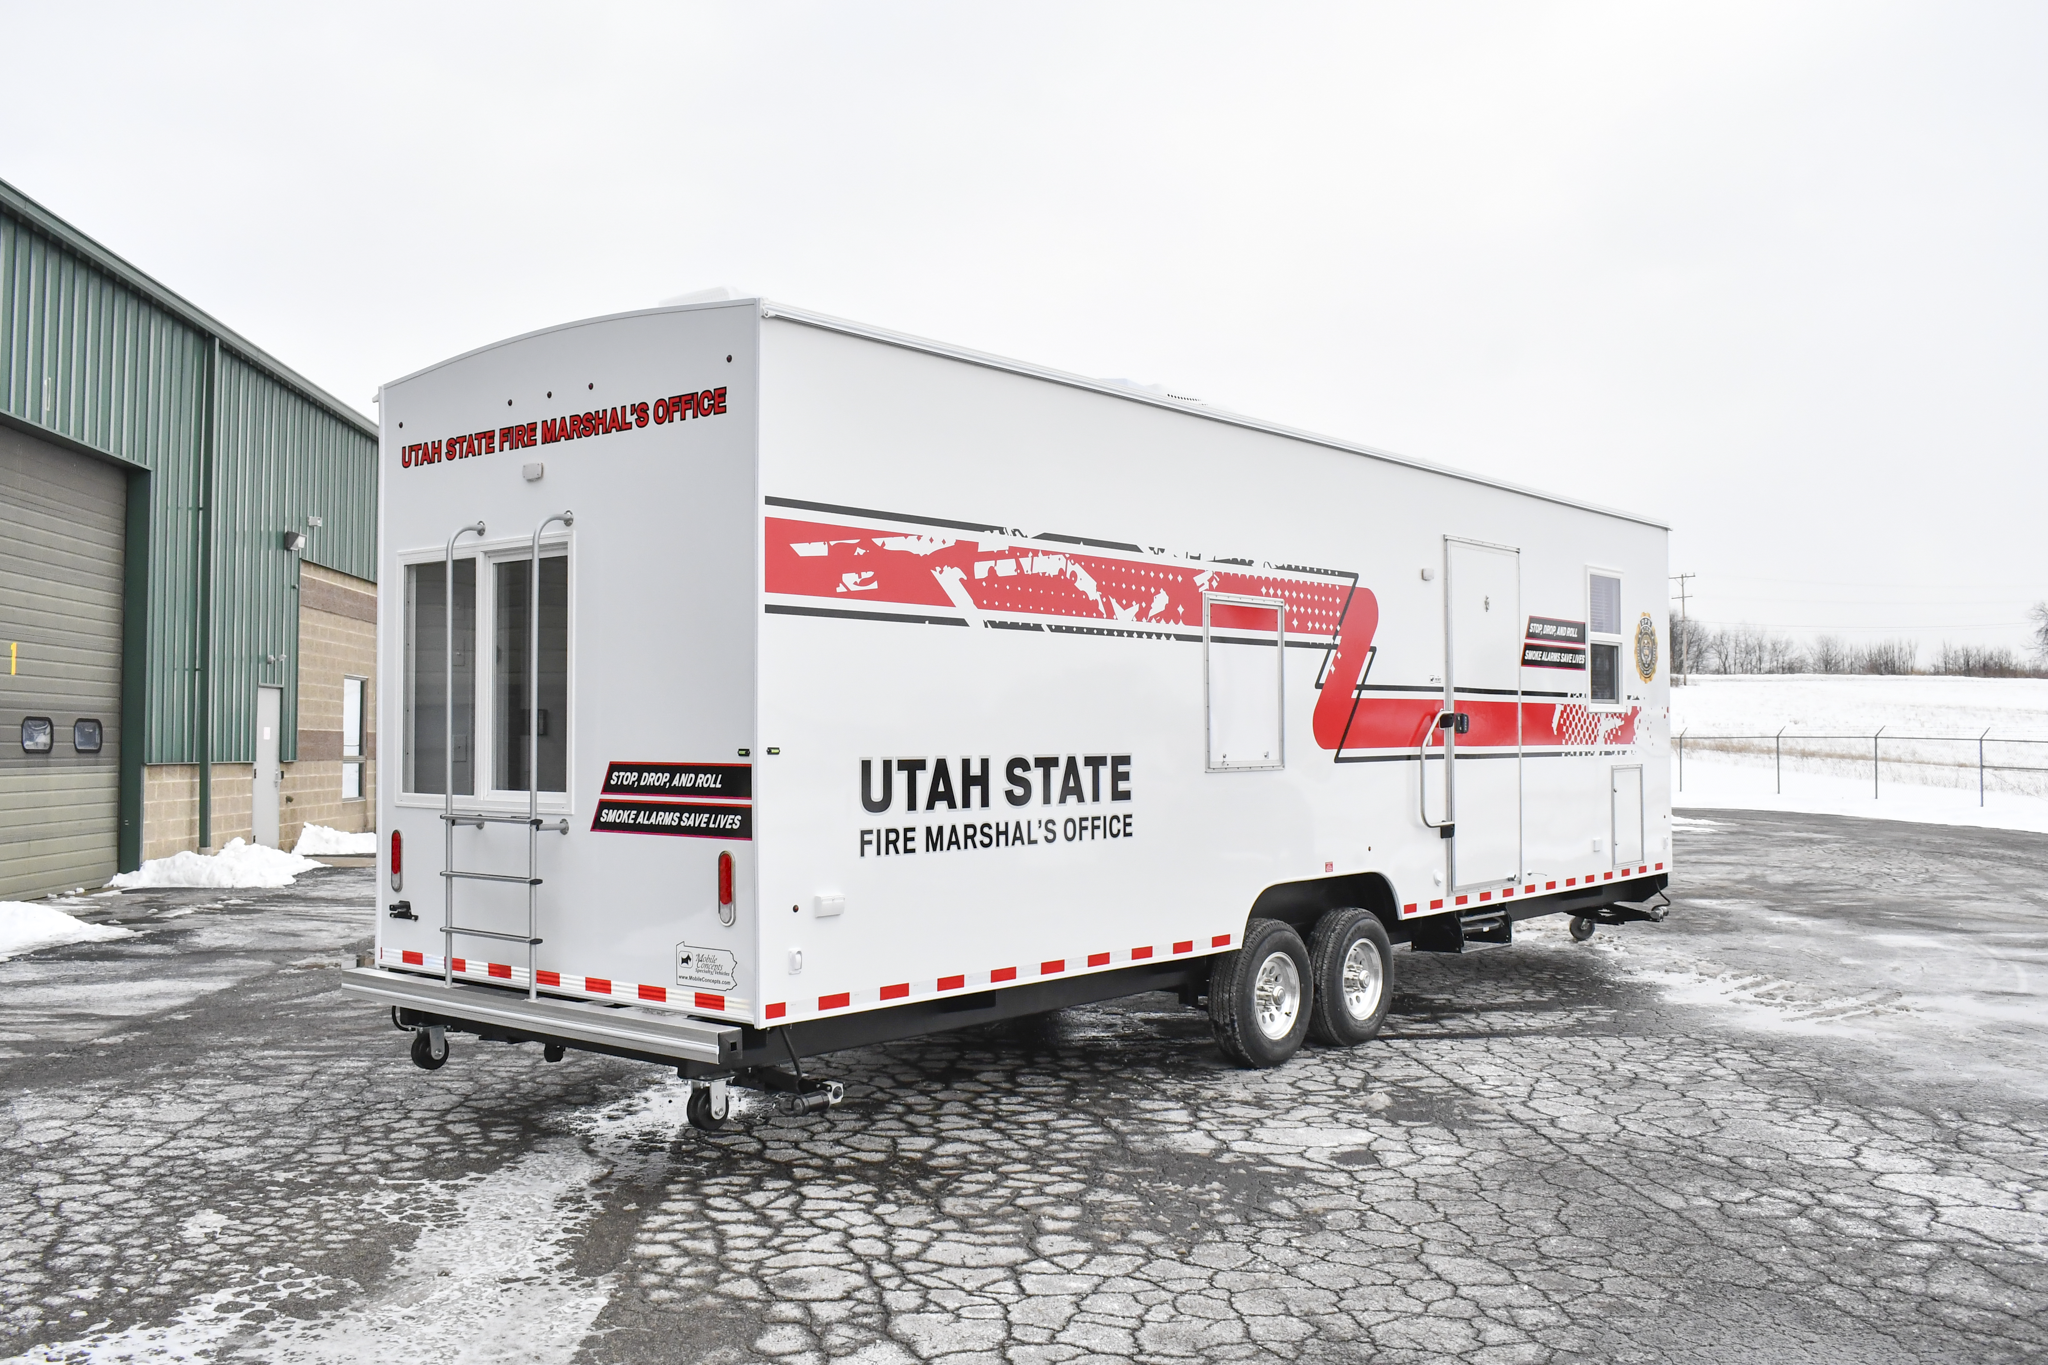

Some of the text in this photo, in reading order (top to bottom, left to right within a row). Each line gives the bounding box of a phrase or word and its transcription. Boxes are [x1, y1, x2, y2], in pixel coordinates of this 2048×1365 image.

[402, 387, 727, 468] UTAH STATE FIRE MARSHAL'S OFFICE
[1557, 626, 1566, 636] AND
[1566, 627, 1577, 637] ROLL
[1525, 650, 1585, 664] SMOKE ALARMS SAVE LIVES
[610, 771, 722, 788] STOP, DROP, AND ROLL
[860, 754, 1132, 814] UTAH STATE
[600, 809, 742, 829] SMOKE ALARMS SAVE LIVES
[860, 814, 1133, 858] FIRE MARSHAL'S OFFICE
[696, 953, 717, 964] Mobile
